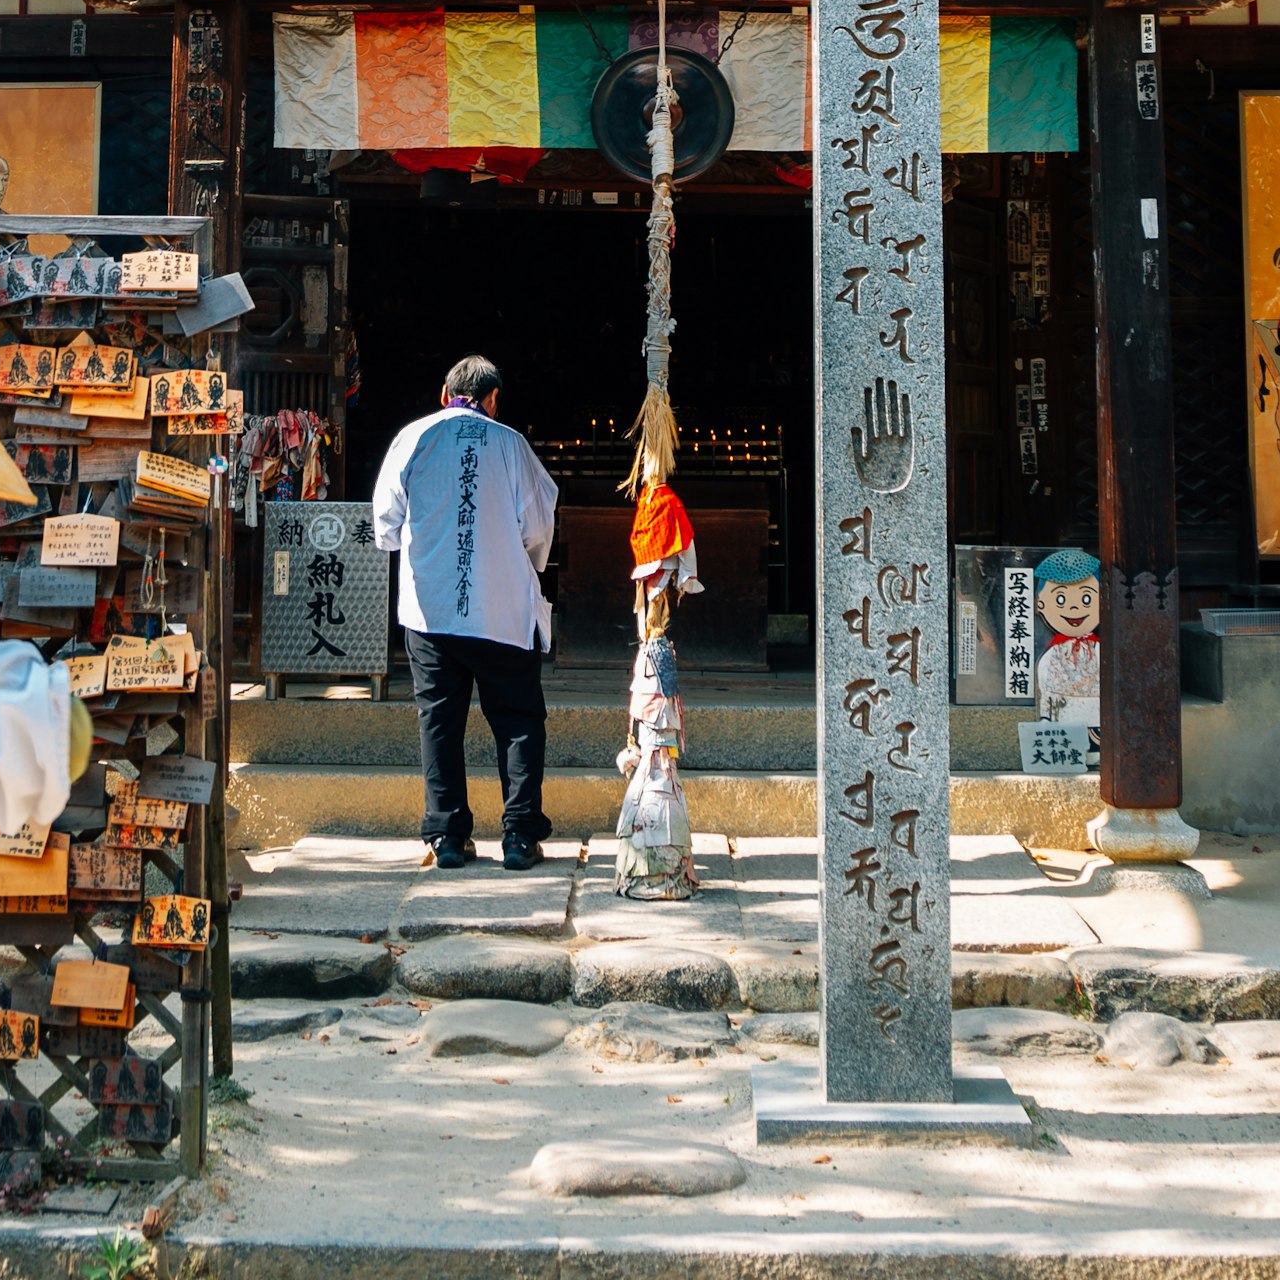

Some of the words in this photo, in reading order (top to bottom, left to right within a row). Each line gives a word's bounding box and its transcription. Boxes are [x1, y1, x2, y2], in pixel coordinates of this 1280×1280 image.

[277, 519, 304, 548] 納
[306, 554, 347, 657] 納札入
[1008, 571, 1031, 696] 写経奉納箱
[1031, 748, 1084, 766] 大師堂
[1032, 738, 1072, 749] 石手寺
